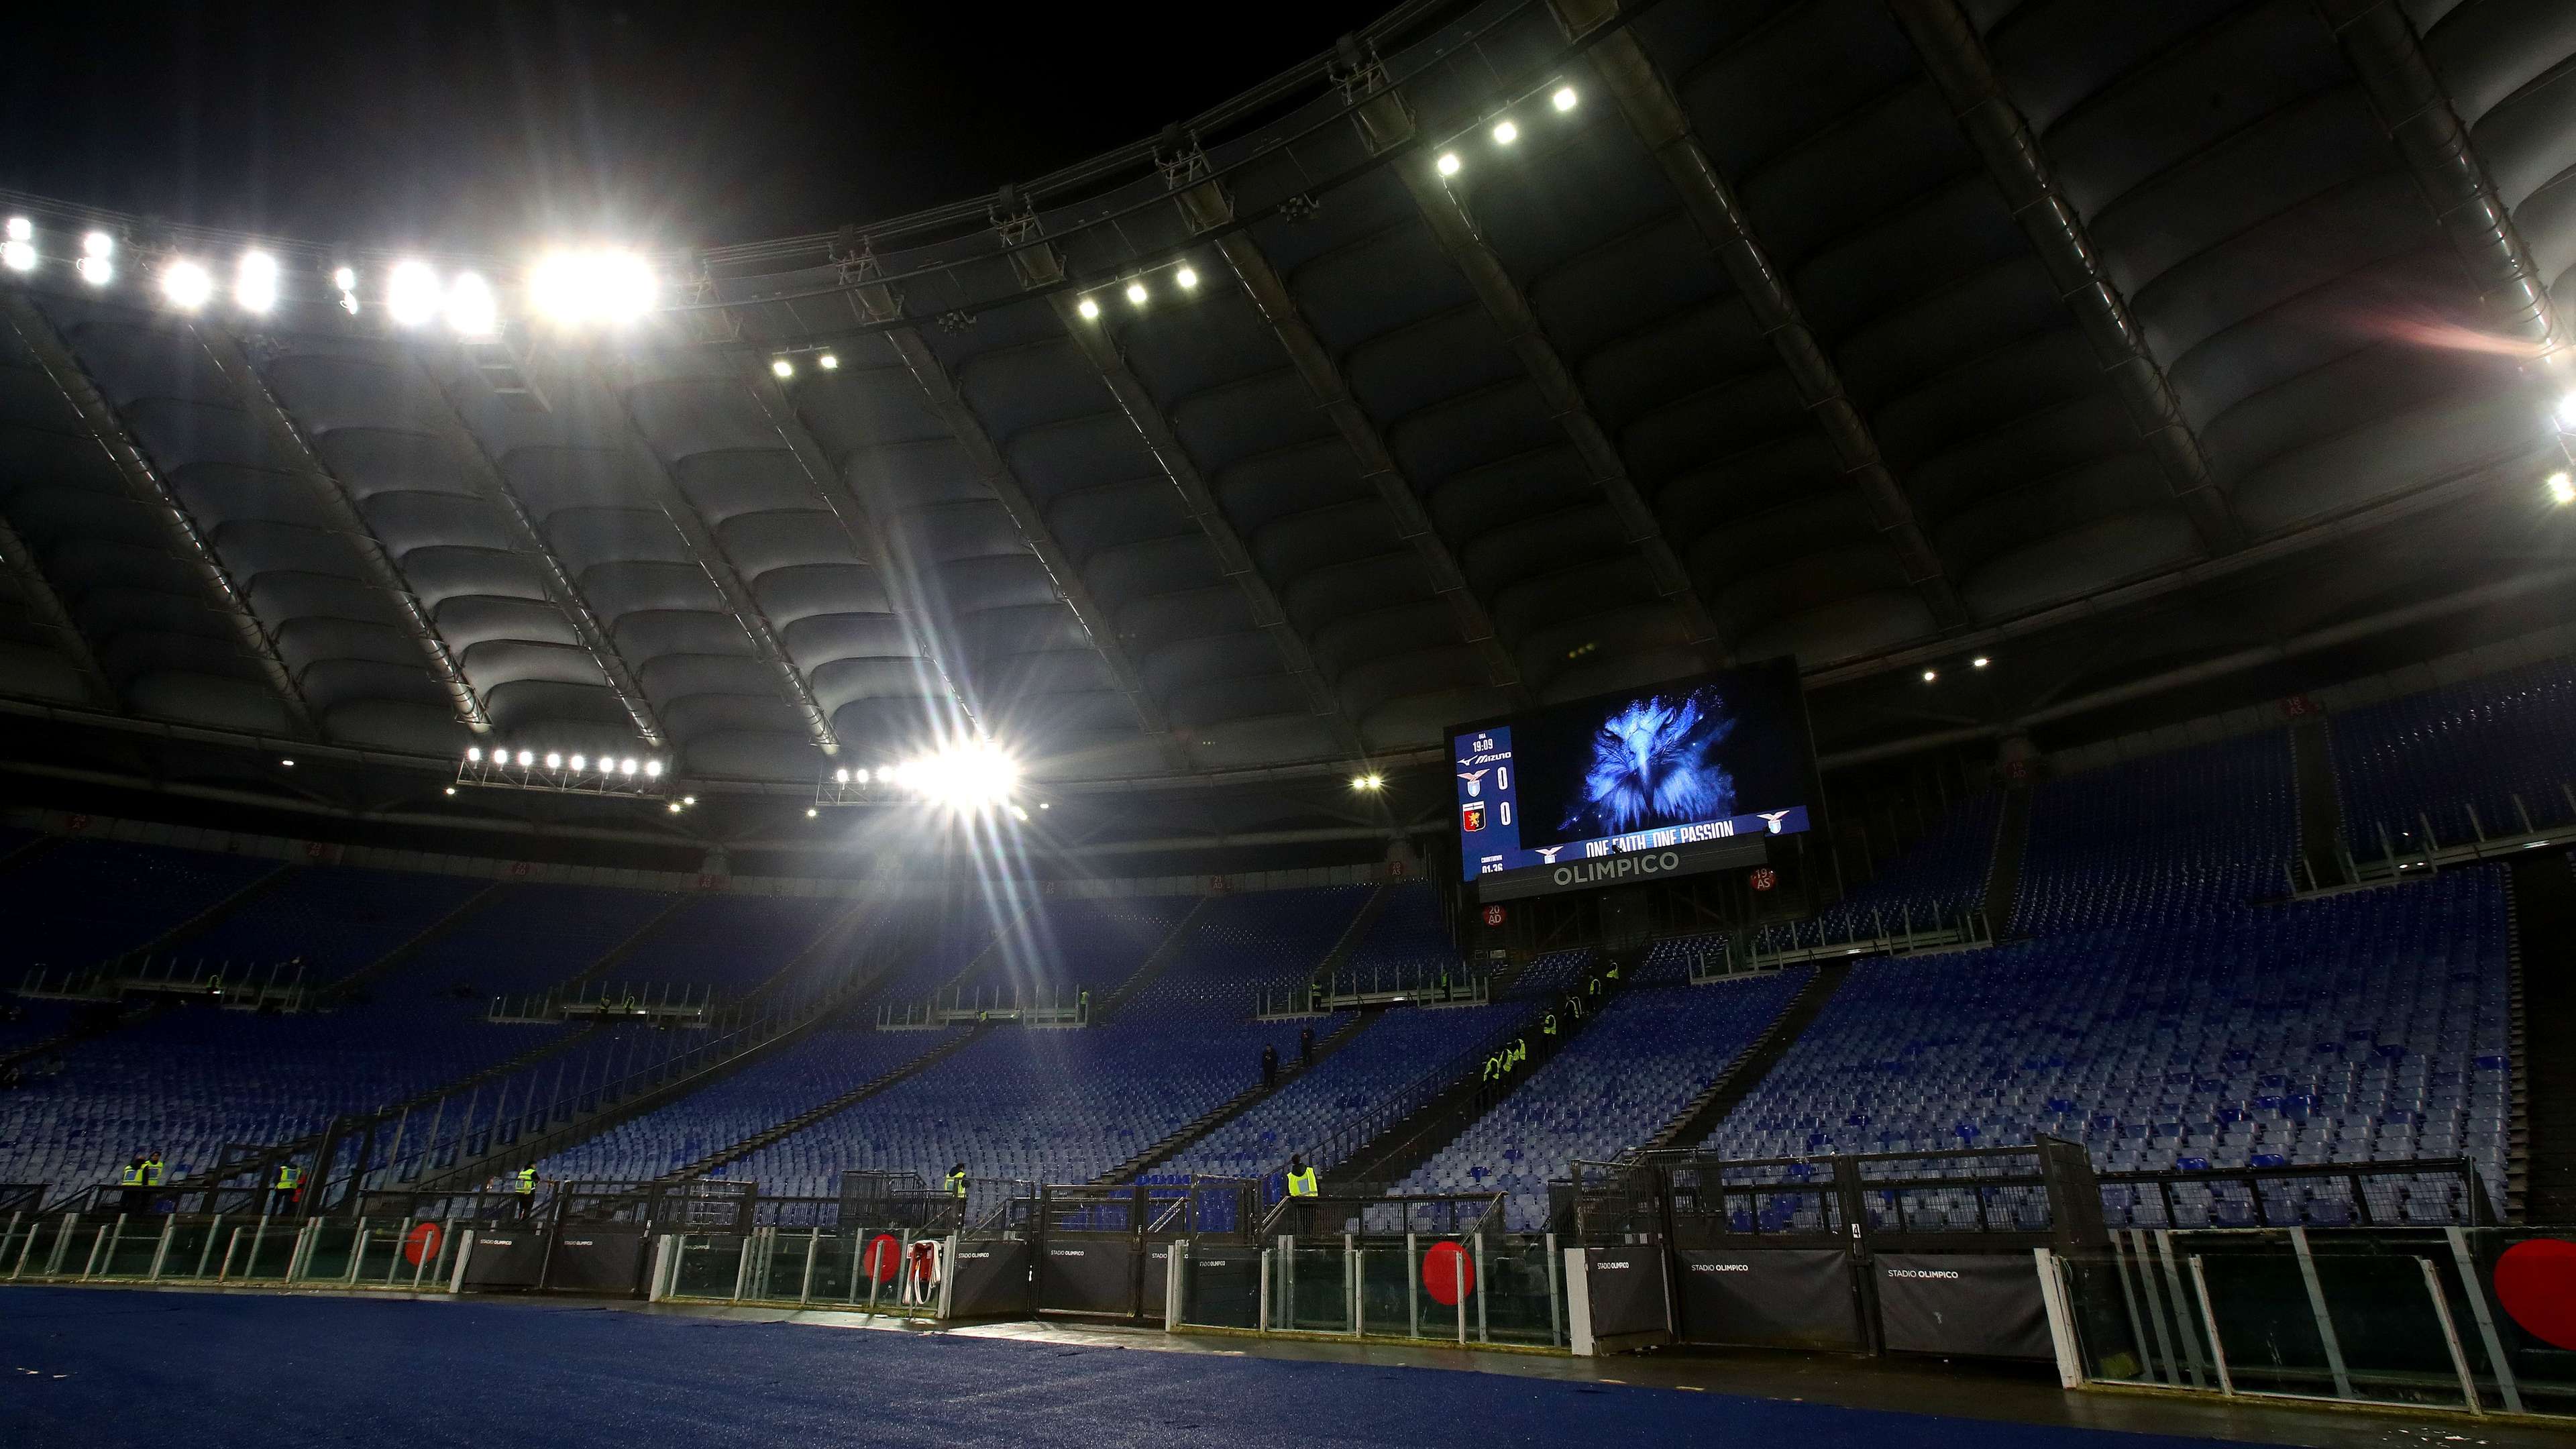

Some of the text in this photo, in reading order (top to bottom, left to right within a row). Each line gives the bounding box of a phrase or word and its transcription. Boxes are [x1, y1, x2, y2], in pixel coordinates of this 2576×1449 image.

[1472, 739, 1493, 752] 19:09
[1497, 767, 1508, 790] 0
[1500, 802, 1511, 826] 0
[1586, 839, 1609, 858] ONE
[1652, 829, 1677, 848] ONE
[1680, 820, 1735, 843] PASSION
[1554, 852, 1679, 885] OLIMPICO
[1756, 868, 1767, 879] 19
[1758, 877, 1770, 889] AS
[1489, 904, 1500, 914] 20
[1489, 914, 1501, 924] AD
[1854, 1225, 1860, 1237] 4
[1888, 1269, 1958, 1279] STADIO OLIMPICO
